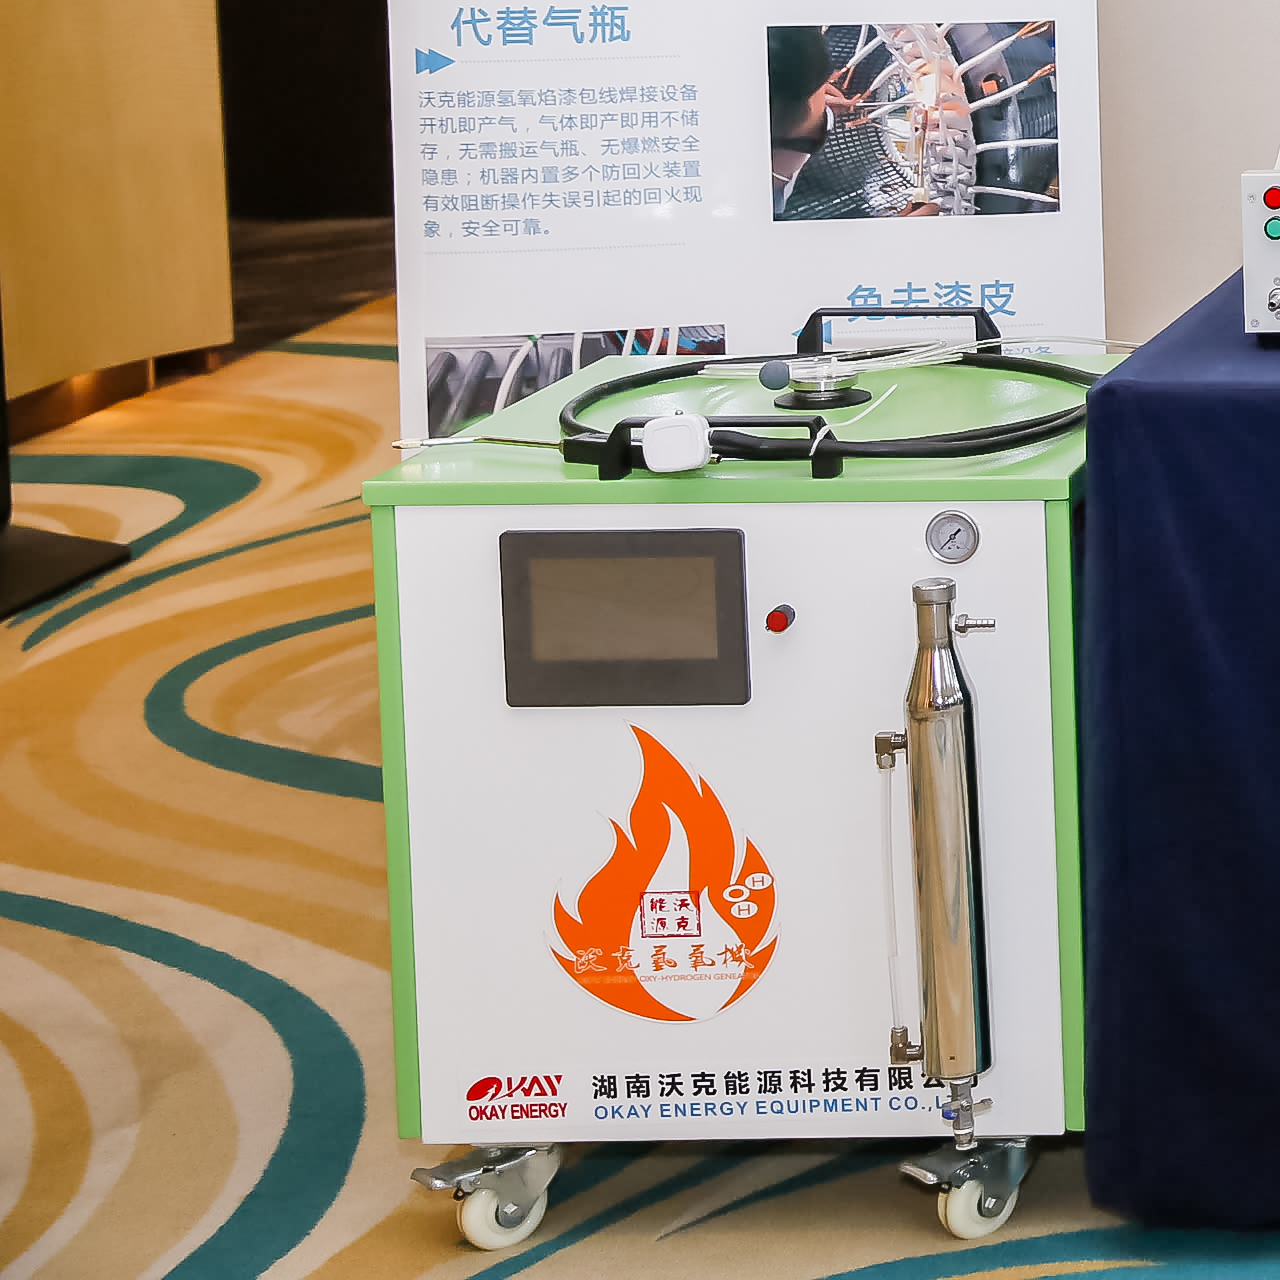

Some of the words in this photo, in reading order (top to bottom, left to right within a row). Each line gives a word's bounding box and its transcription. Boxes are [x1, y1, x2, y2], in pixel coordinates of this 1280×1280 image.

[450, 4, 632, 47] 代替气瓶
[418, 84, 698, 109] 沃克能源氢氧焰漆包线焊接设备
[423, 218, 550, 238] 象，安全可靠。
[466, 1074, 563, 1102] OKAY
[591, 1066, 979, 1100] 湖南沃克能源科技有限公
[468, 1104, 509, 1121] OKAY
[510, 1102, 568, 1120] ENERGY
[594, 1104, 653, 1120] OKAY
[659, 1100, 749, 1118] ENERGY
[755, 1097, 882, 1115] EQUIPMENT
